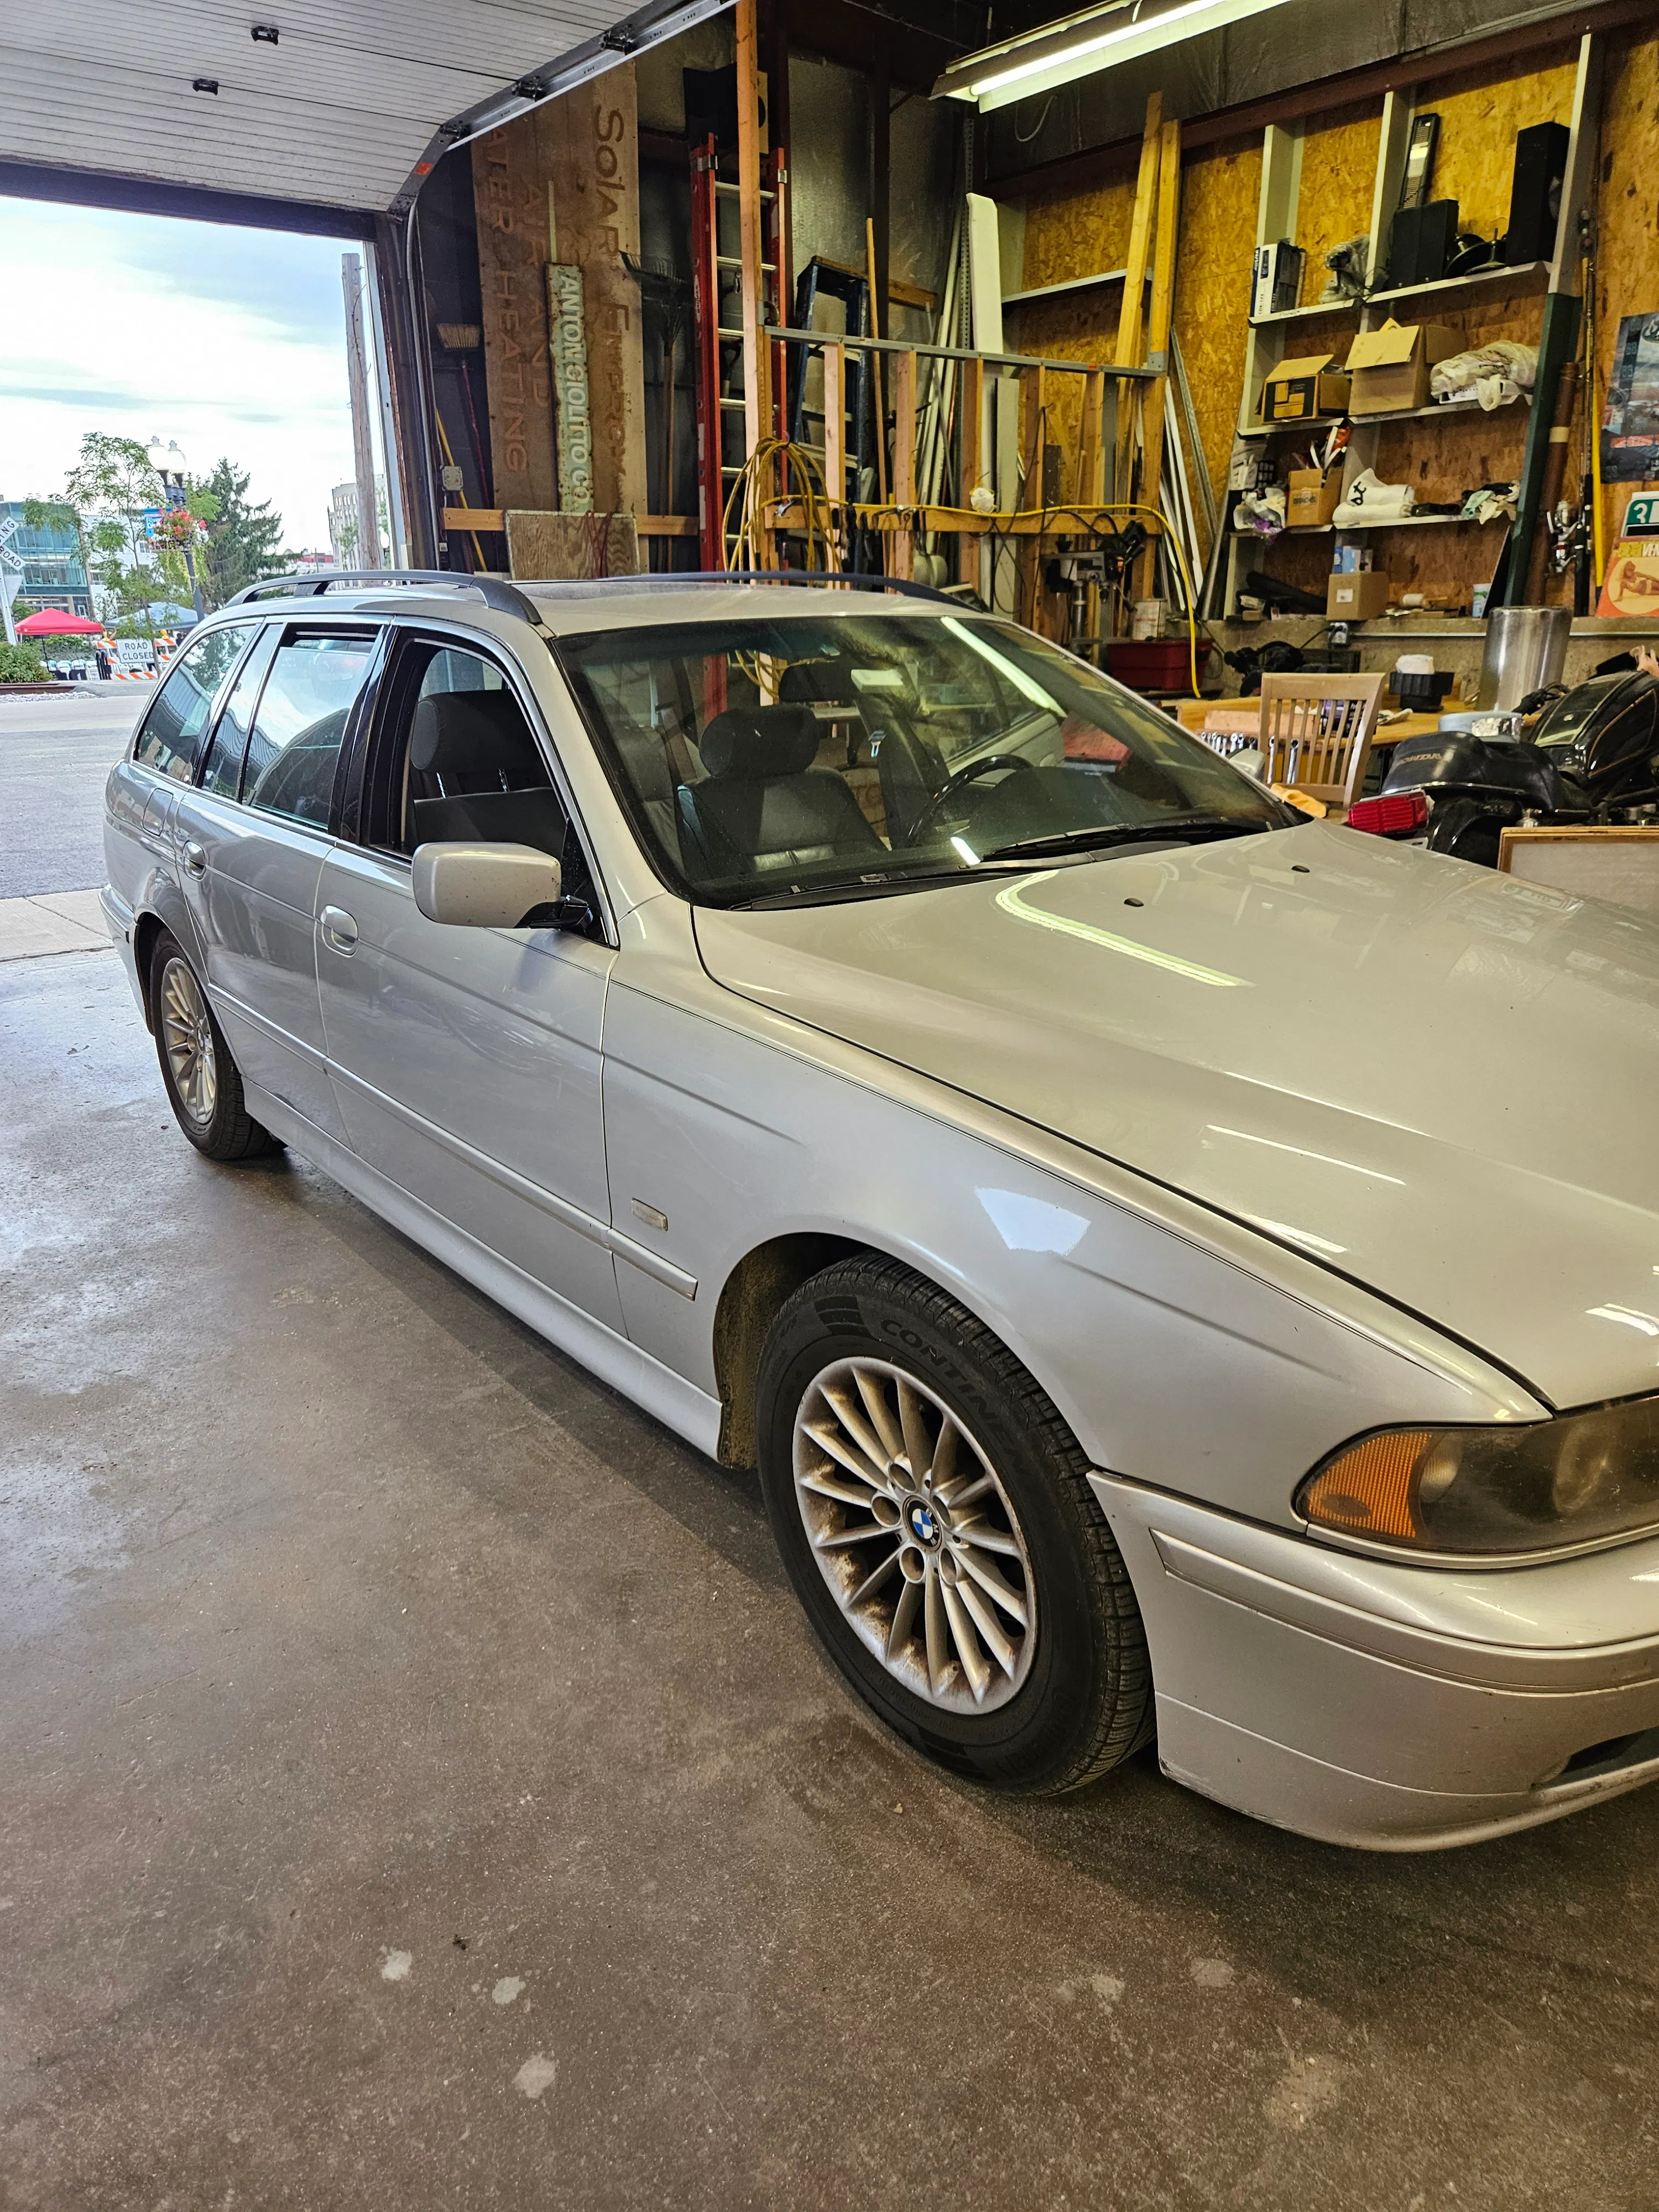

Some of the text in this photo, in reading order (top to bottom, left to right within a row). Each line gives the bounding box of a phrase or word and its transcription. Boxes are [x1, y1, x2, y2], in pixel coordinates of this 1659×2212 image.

[487, 127, 528, 473] ATER HEATING
[560, 275, 582, 358] ANTON
[565, 364, 588, 464] GIOLITTO
[0, 520, 15, 542] ING
[122, 652, 154, 660] CLOSED
